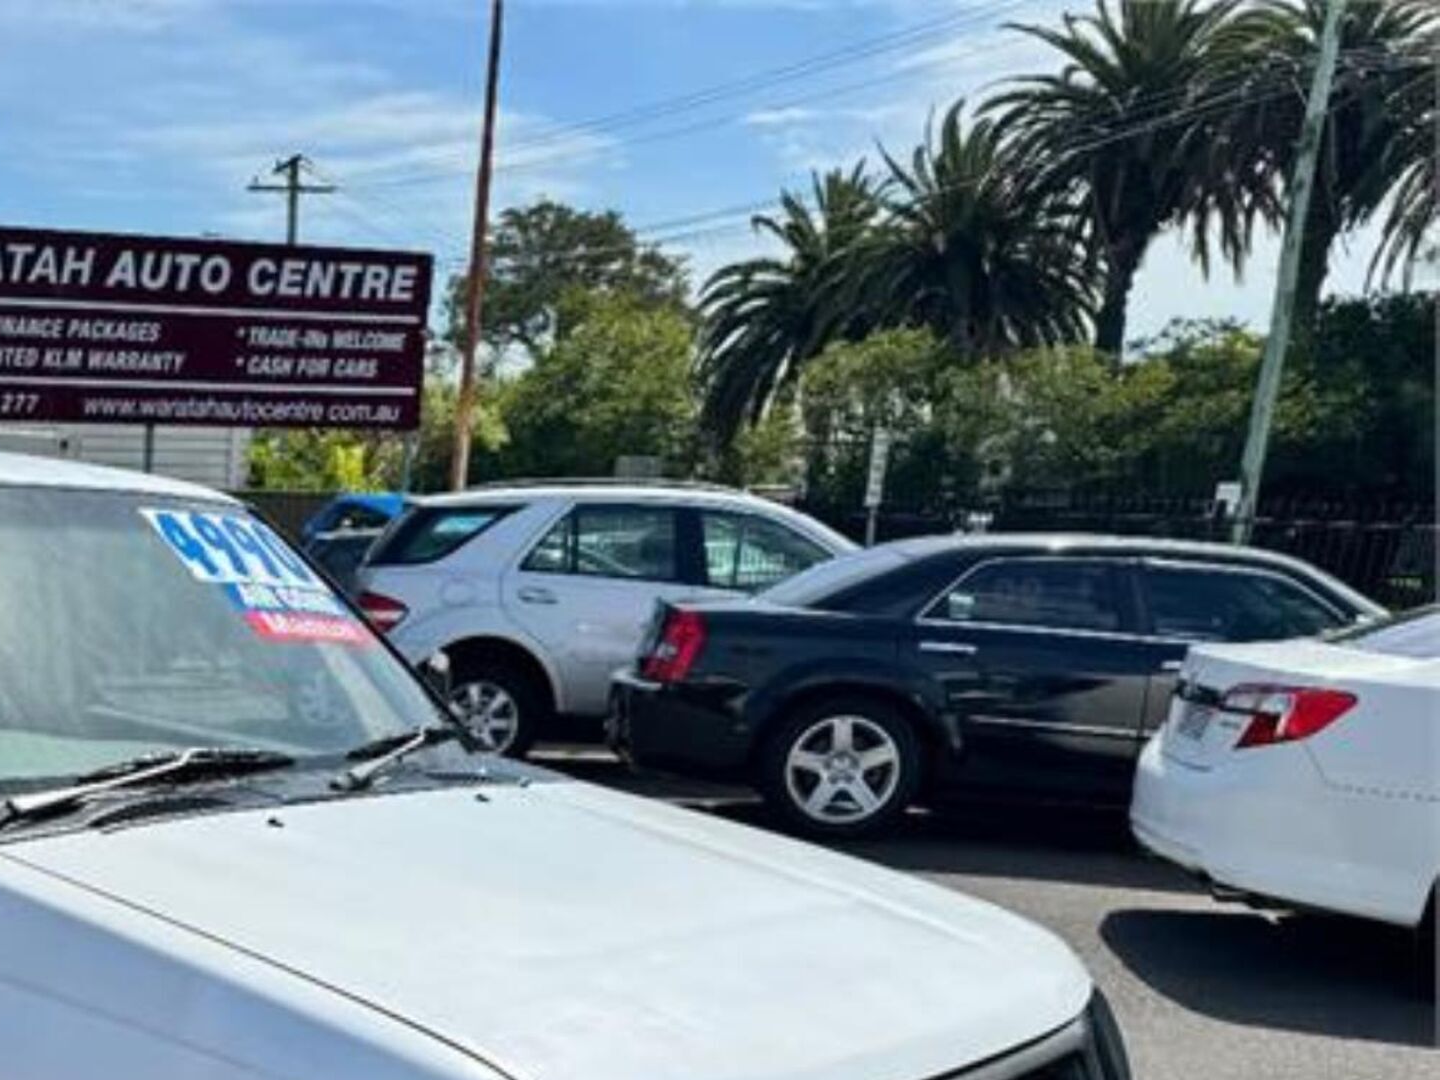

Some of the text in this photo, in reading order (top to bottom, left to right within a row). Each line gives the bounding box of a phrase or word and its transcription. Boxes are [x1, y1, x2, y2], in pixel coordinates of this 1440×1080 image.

[106, 249, 231, 292] AUTO
[247, 258, 417, 300] CENTRE
[66, 319, 162, 342] PACKAGES
[88, 350, 185, 373] WARRANTY
[247, 355, 378, 377] CASH FOR CARS
